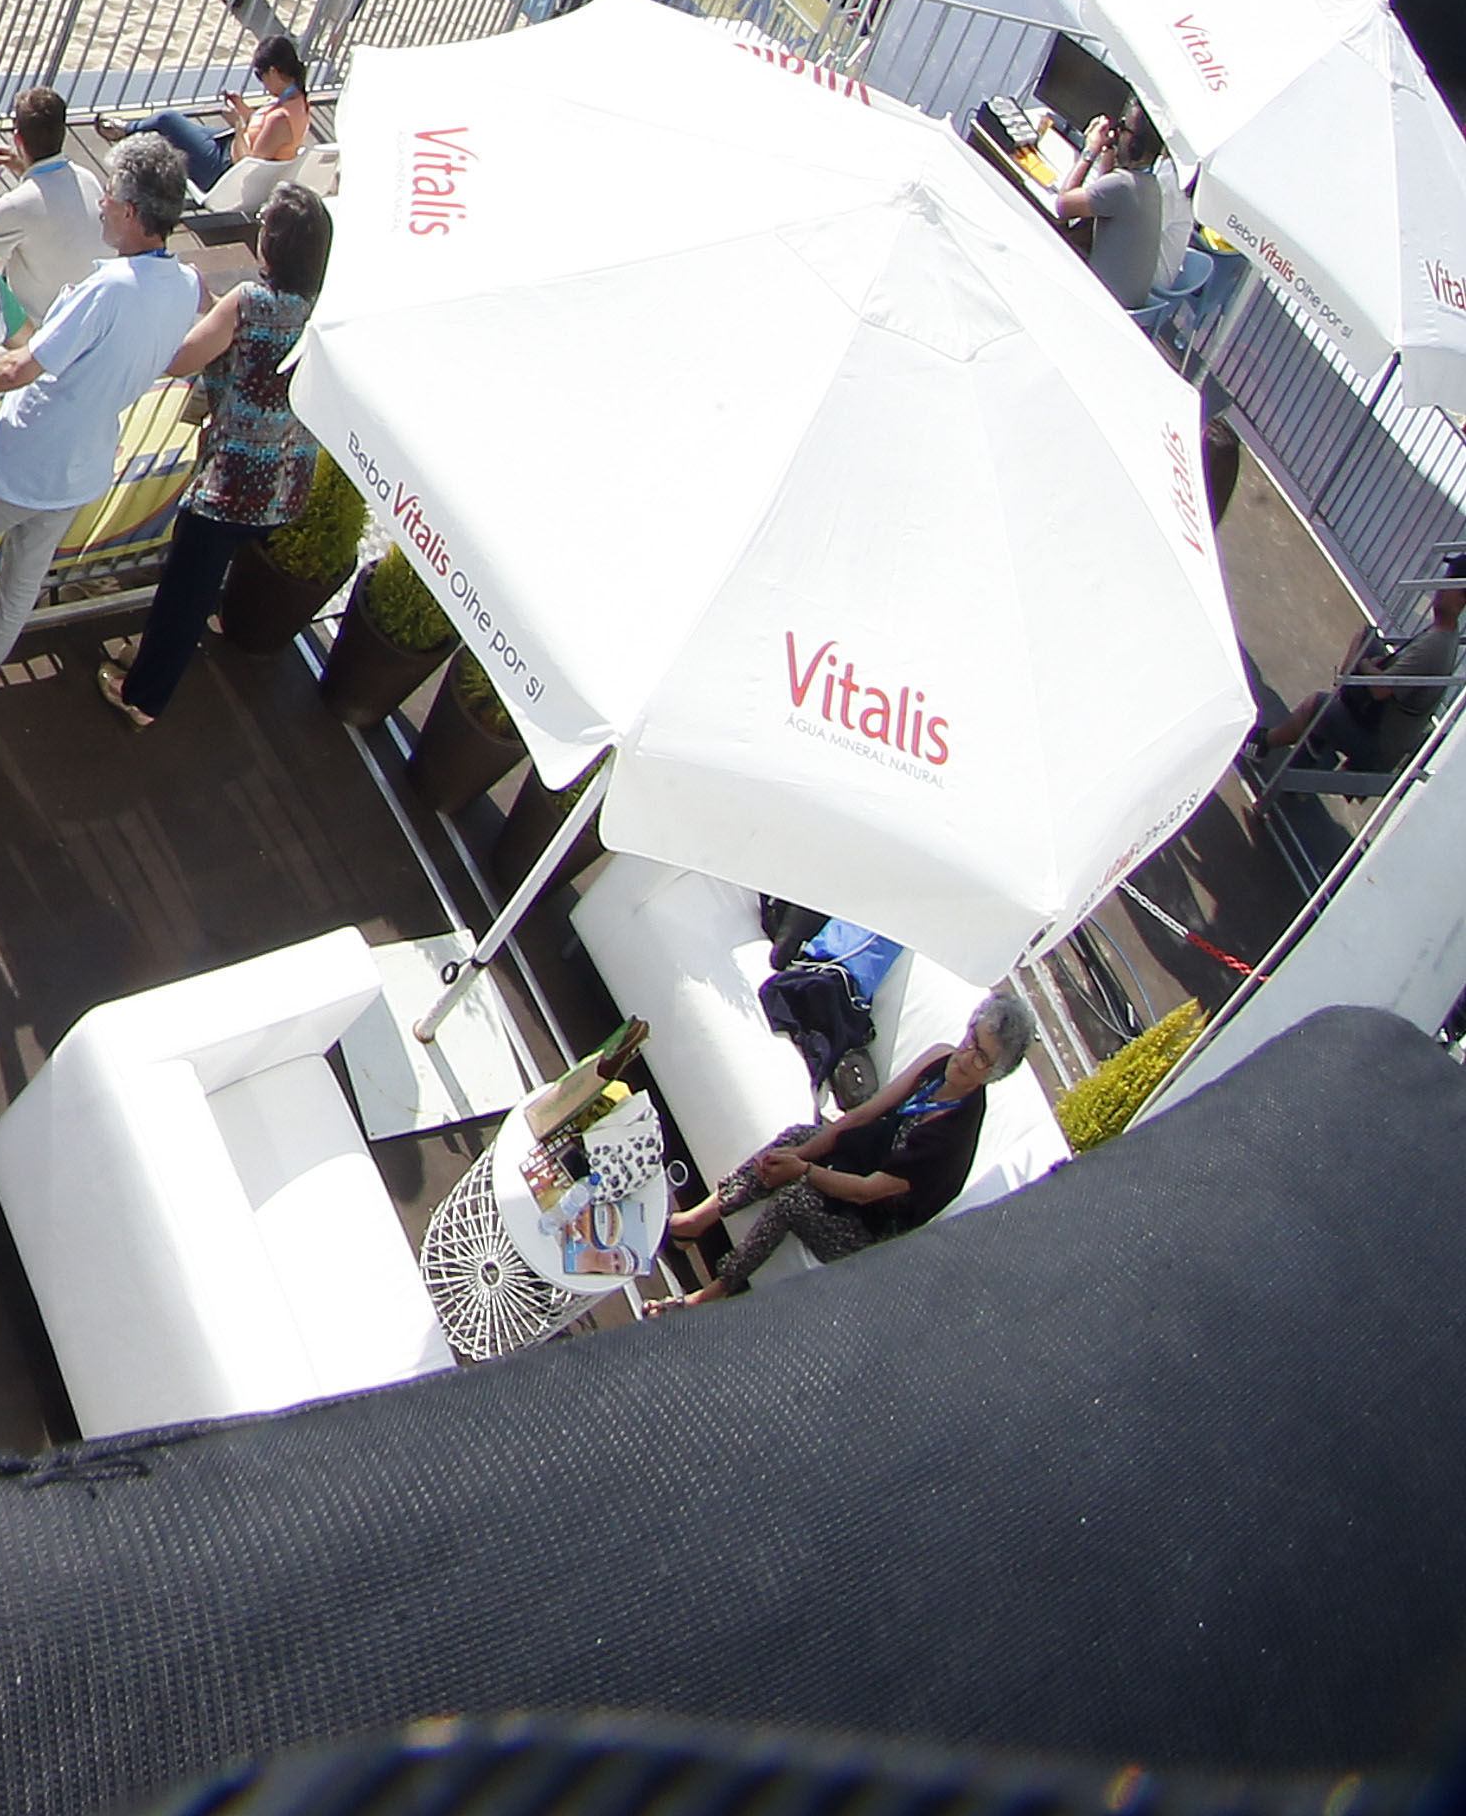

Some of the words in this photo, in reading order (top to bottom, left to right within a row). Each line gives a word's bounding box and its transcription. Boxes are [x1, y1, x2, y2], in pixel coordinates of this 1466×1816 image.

[1173, 14, 1230, 93] Vitalis
[409, 126, 480, 236] Vitalis
[1225, 213, 1259, 250] Beba
[1255, 235, 1296, 284] Vitalis
[1293, 276, 1323, 309] Olhe
[1318, 303, 1344, 330] por
[1160, 420, 1205, 556] Vitalis
[345, 429, 393, 505] Beba
[390, 476, 453, 581] Vitalis
[446, 567, 496, 635] Olhe
[488, 625, 531, 682] por
[521, 668, 548, 706] si
[784, 628, 952, 770] Vitalis
[785, 710, 827, 741] ÁGUA
[827, 731, 886, 768] MINERAL
[887, 754, 947, 791] NATURAL
